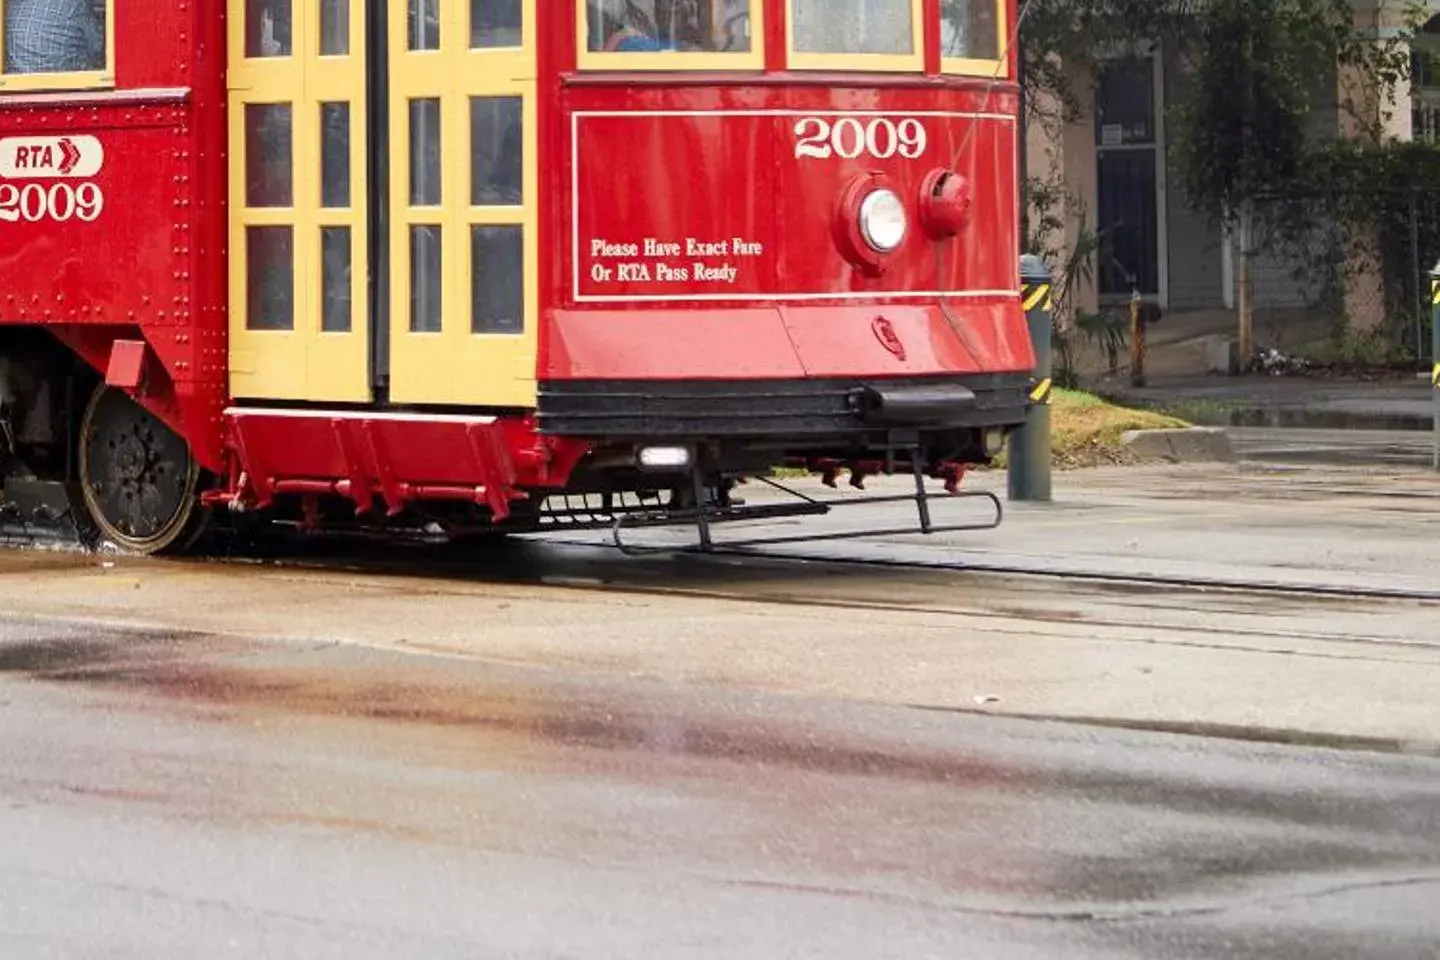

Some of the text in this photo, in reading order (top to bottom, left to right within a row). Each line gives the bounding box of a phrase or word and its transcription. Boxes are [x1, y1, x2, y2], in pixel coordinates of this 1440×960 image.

[794, 117, 927, 159] 2009
[15, 145, 53, 168] RTA
[591, 237, 763, 257] Please Have Exact Fare
[591, 262, 737, 283] Or RTA Pass Ready
